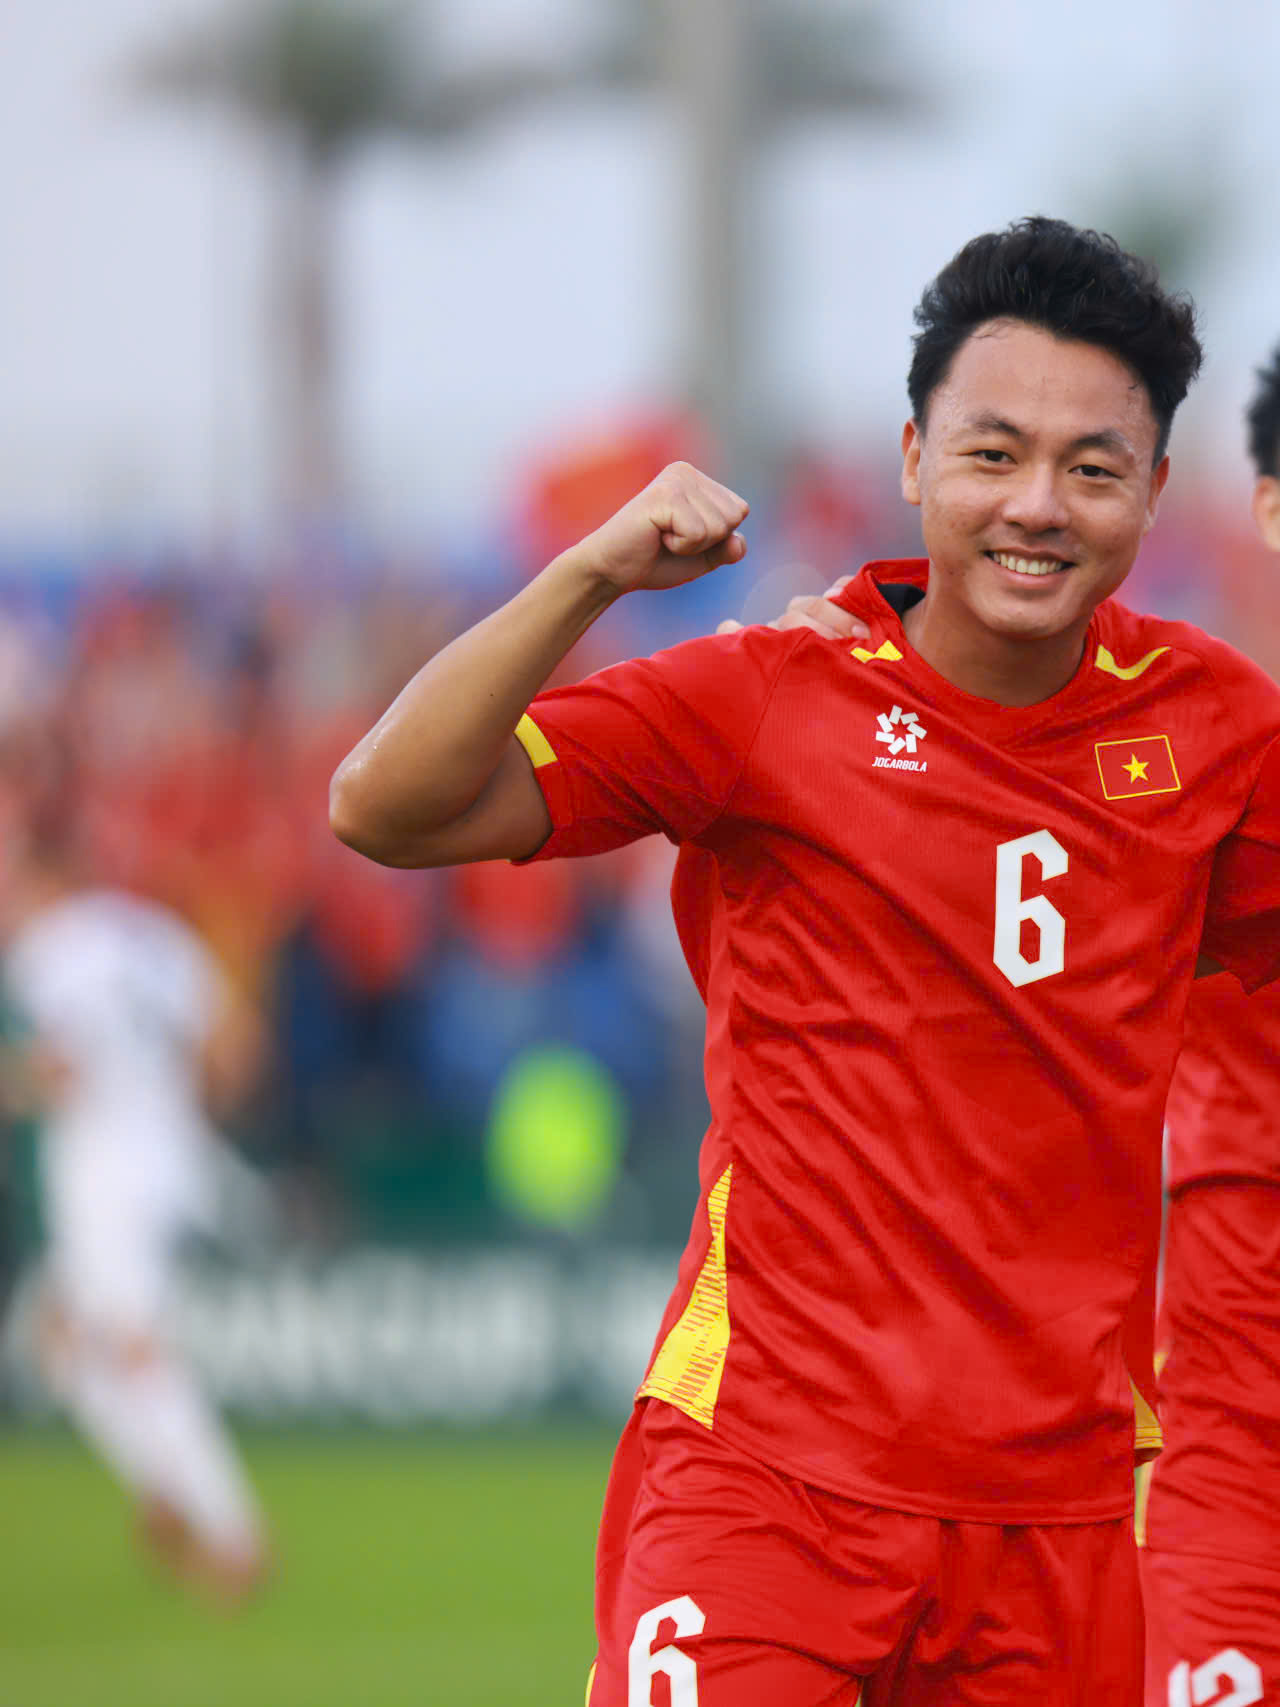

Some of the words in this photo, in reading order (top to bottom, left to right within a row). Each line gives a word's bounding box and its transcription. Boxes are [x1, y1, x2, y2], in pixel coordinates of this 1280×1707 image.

[872, 756, 928, 773] JOCARBOLA
[993, 829, 1069, 988] 6
[628, 1594, 706, 1707] 6
